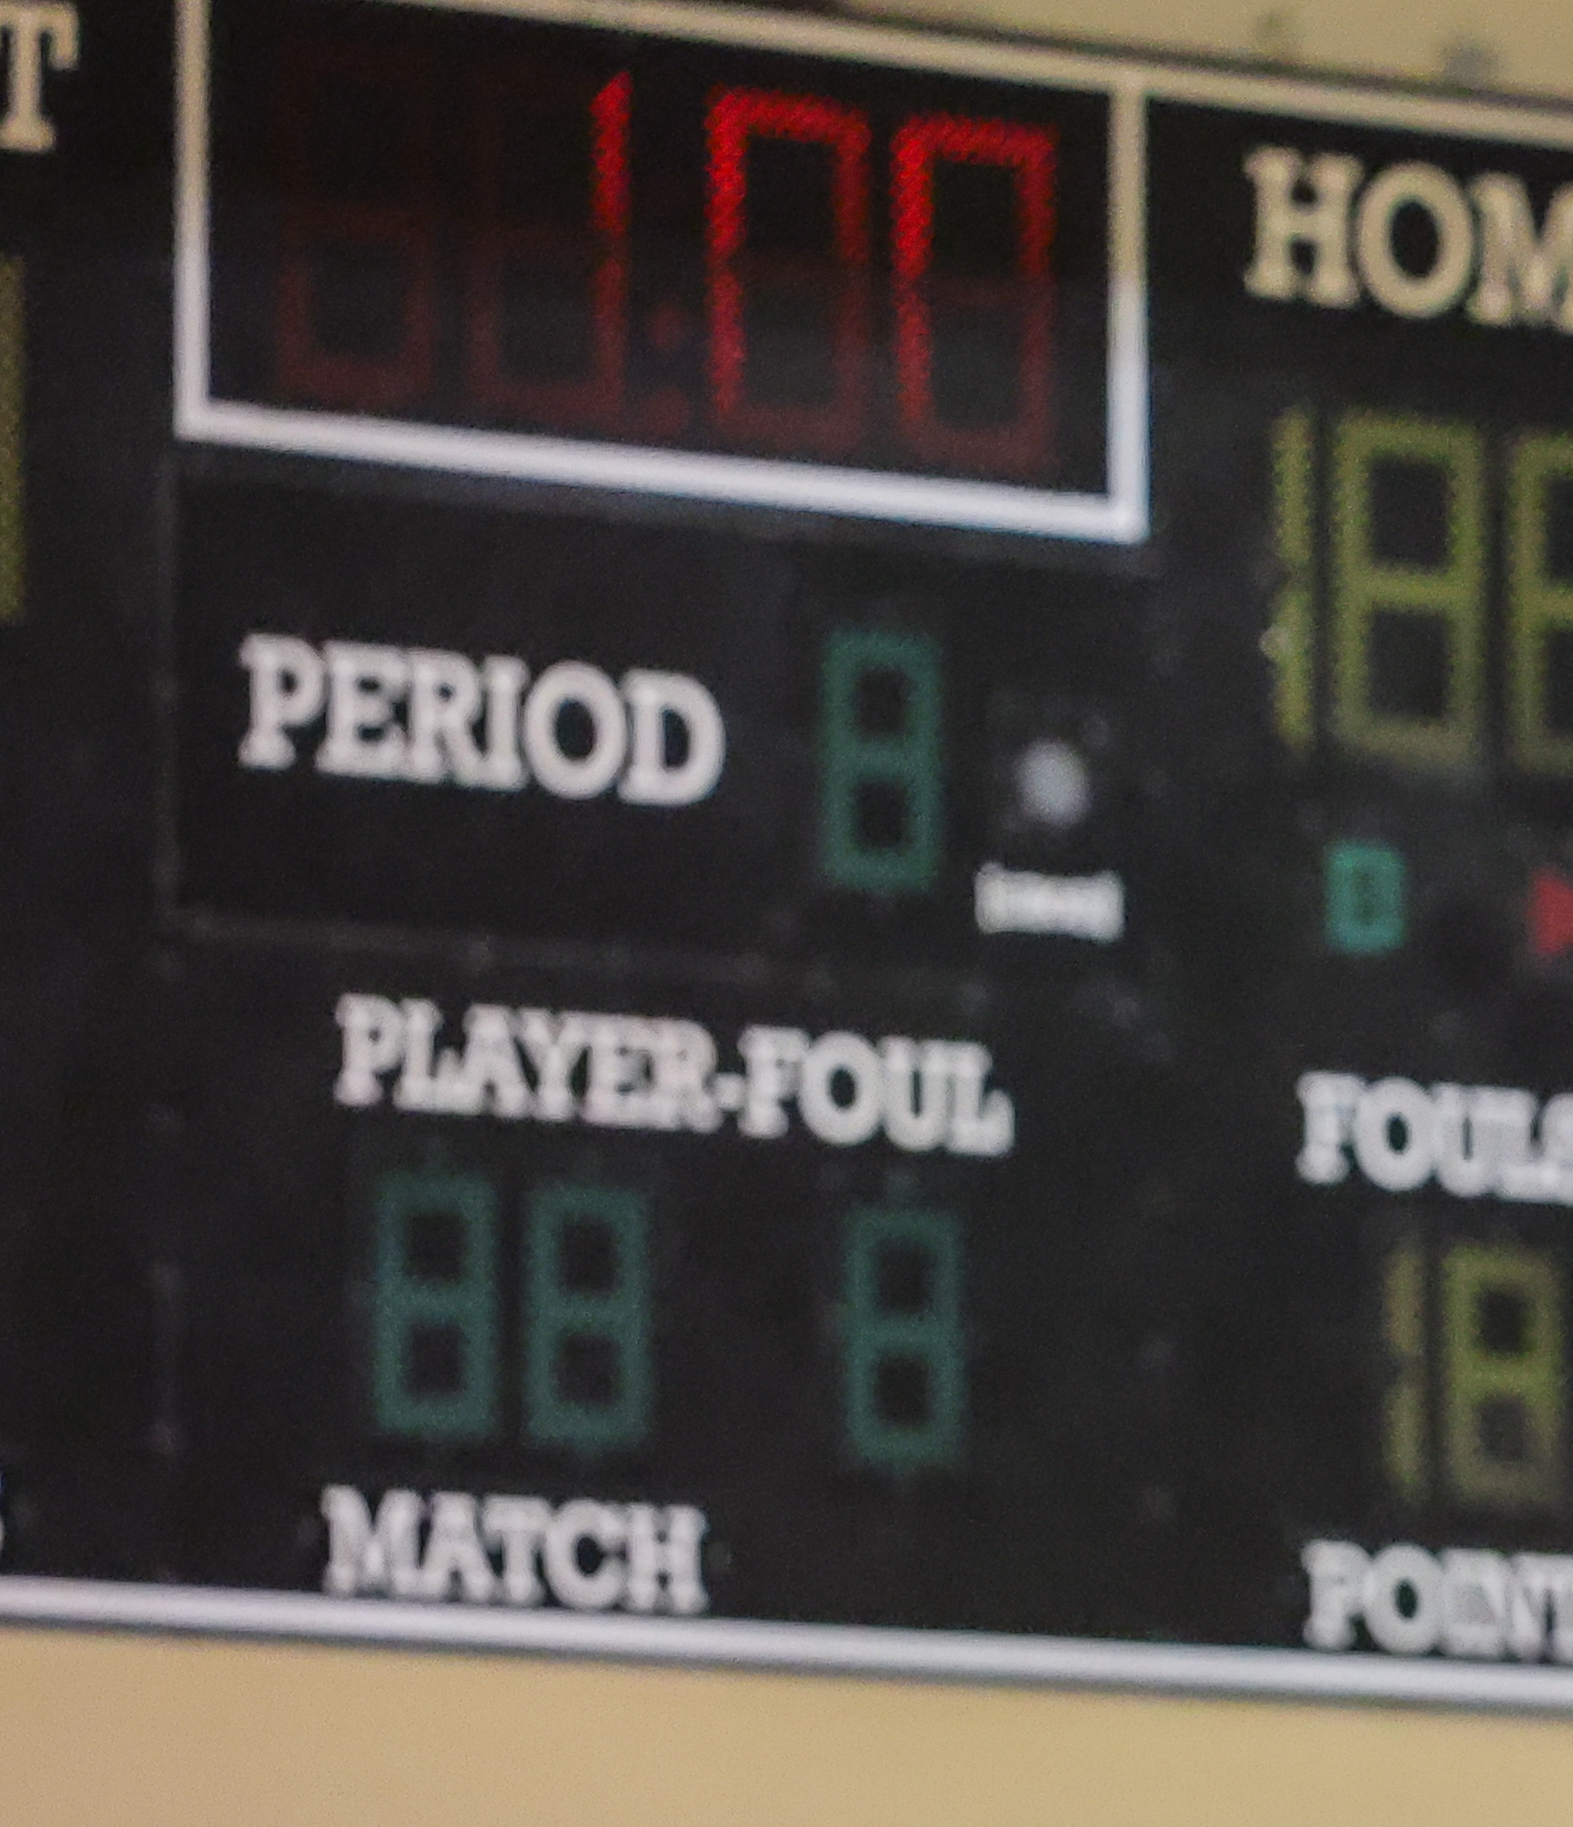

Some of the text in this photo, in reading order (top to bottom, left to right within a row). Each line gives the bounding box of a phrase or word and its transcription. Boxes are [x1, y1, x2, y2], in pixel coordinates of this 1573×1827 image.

[238, 633, 727, 805] PERIOD
[334, 993, 1016, 1158] PLAYER-FOUL
[321, 1485, 709, 1615] MATCH
